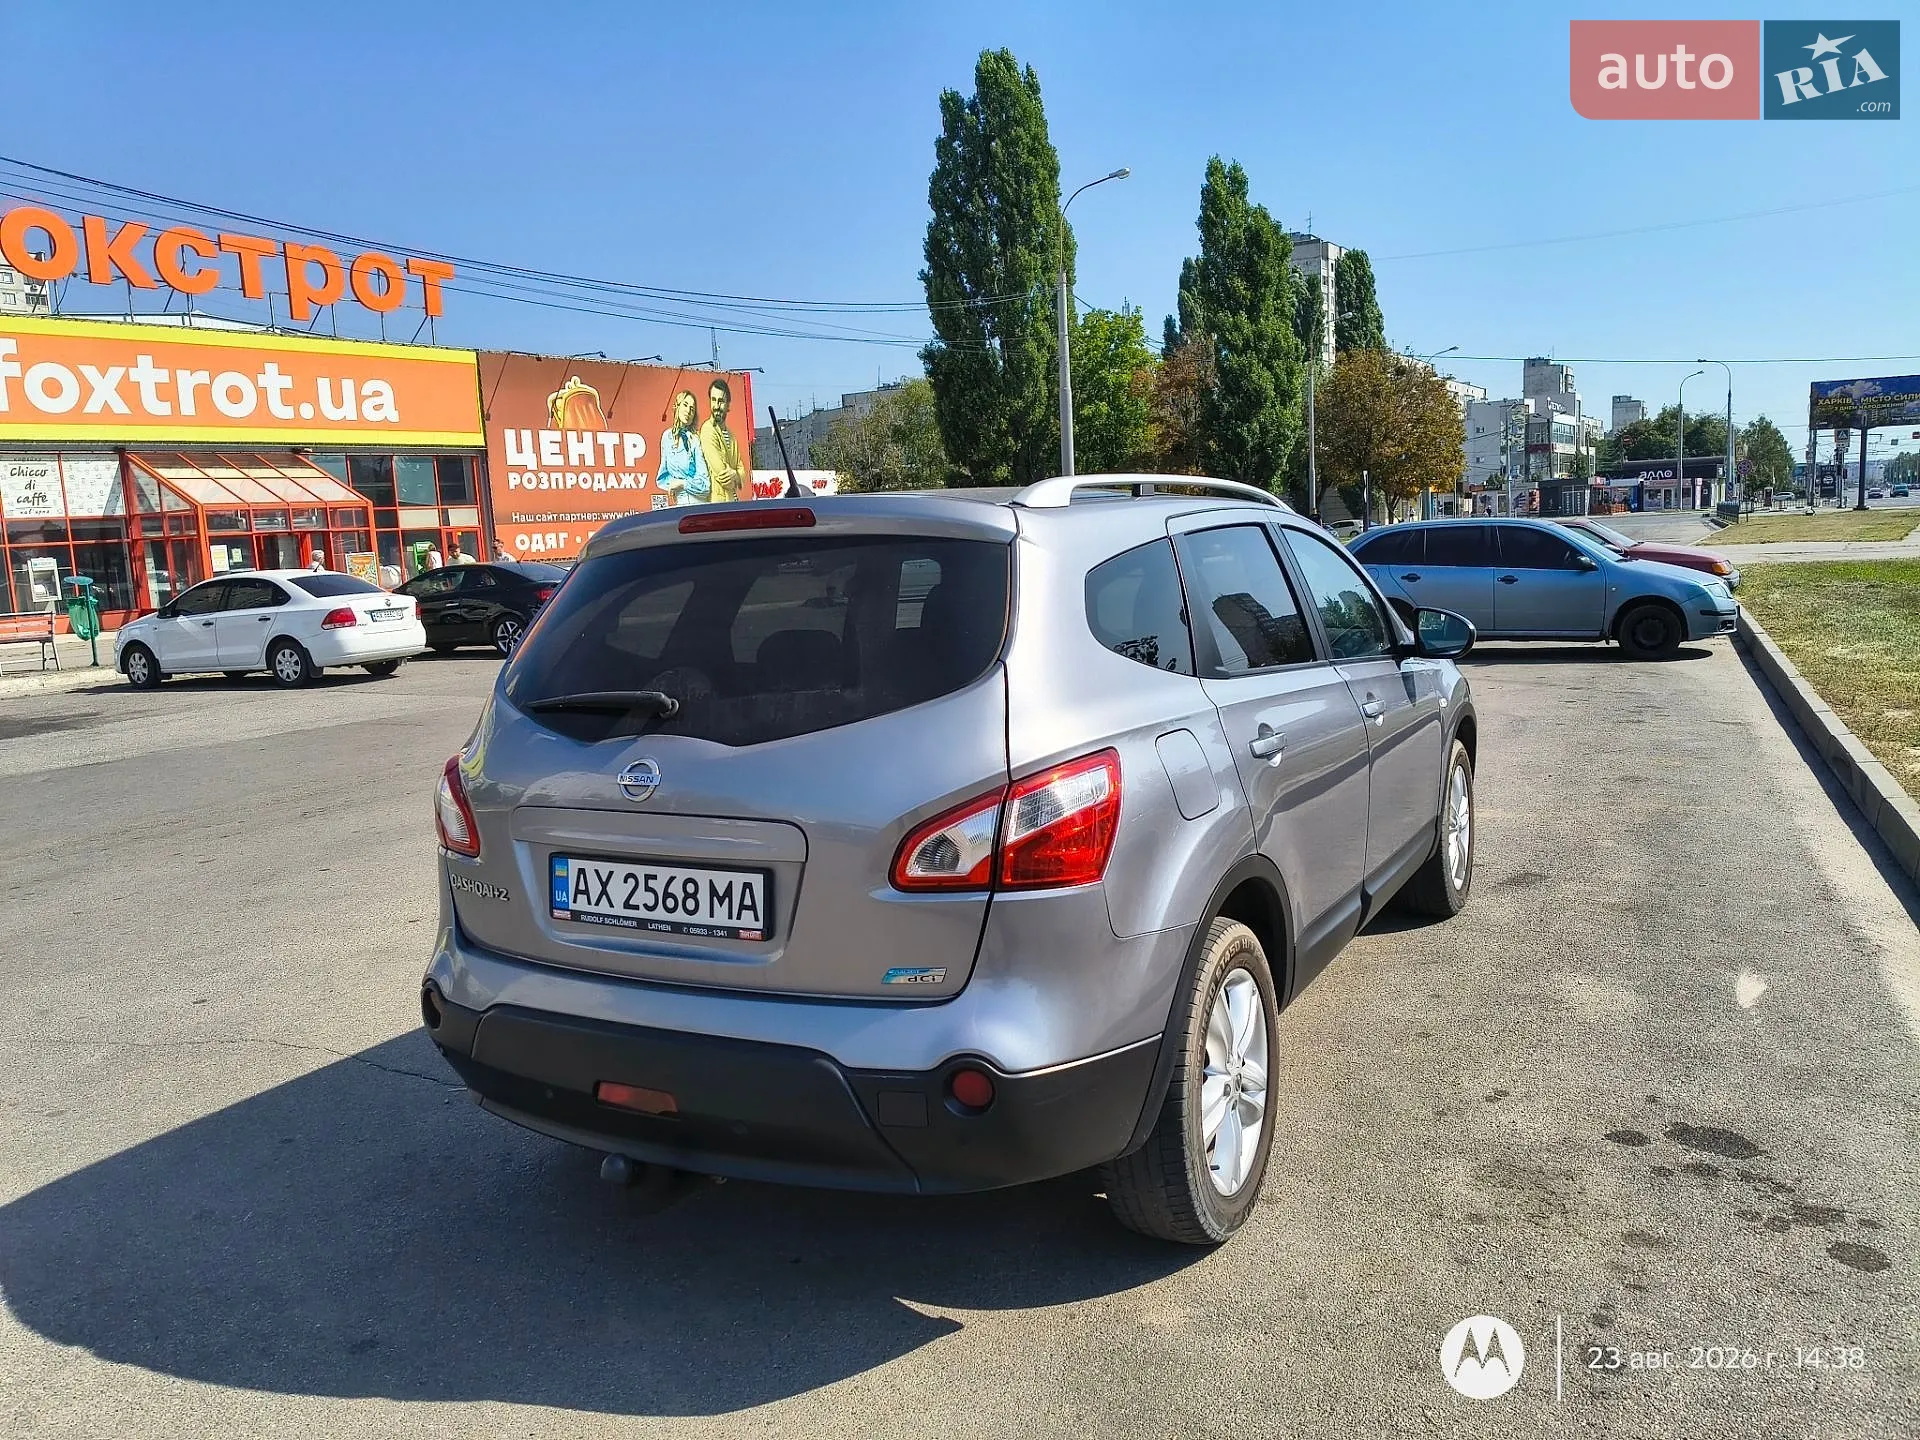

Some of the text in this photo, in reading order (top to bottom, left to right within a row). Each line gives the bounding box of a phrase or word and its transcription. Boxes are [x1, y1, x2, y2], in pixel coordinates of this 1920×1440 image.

[0, 336, 401, 425] foxtrot.ua
[1818, 397, 1853, 406] ХАРКІВ
[1860, 395, 1891, 403] МІСТО
[503, 428, 647, 471] ЦЕНТР
[24, 479, 36, 490] di
[507, 471, 648, 492] РОЗПРОДАЖУ
[511, 512, 535, 523] Наш
[536, 511, 560, 522] сайт
[560, 512, 600, 523] партнер:
[515, 532, 569, 552] ОДЯГ
[619, 775, 654, 783] NISSAN
[555, 890, 568, 903] UA
[572, 867, 760, 922] AX 2568 MA
[580, 914, 604, 924] RUDOLF
[647, 922, 672, 932] LATHEN
[689, 927, 708, 936] 05933
[713, 929, 728, 937] 1341
[907, 975, 936, 983] dCi
